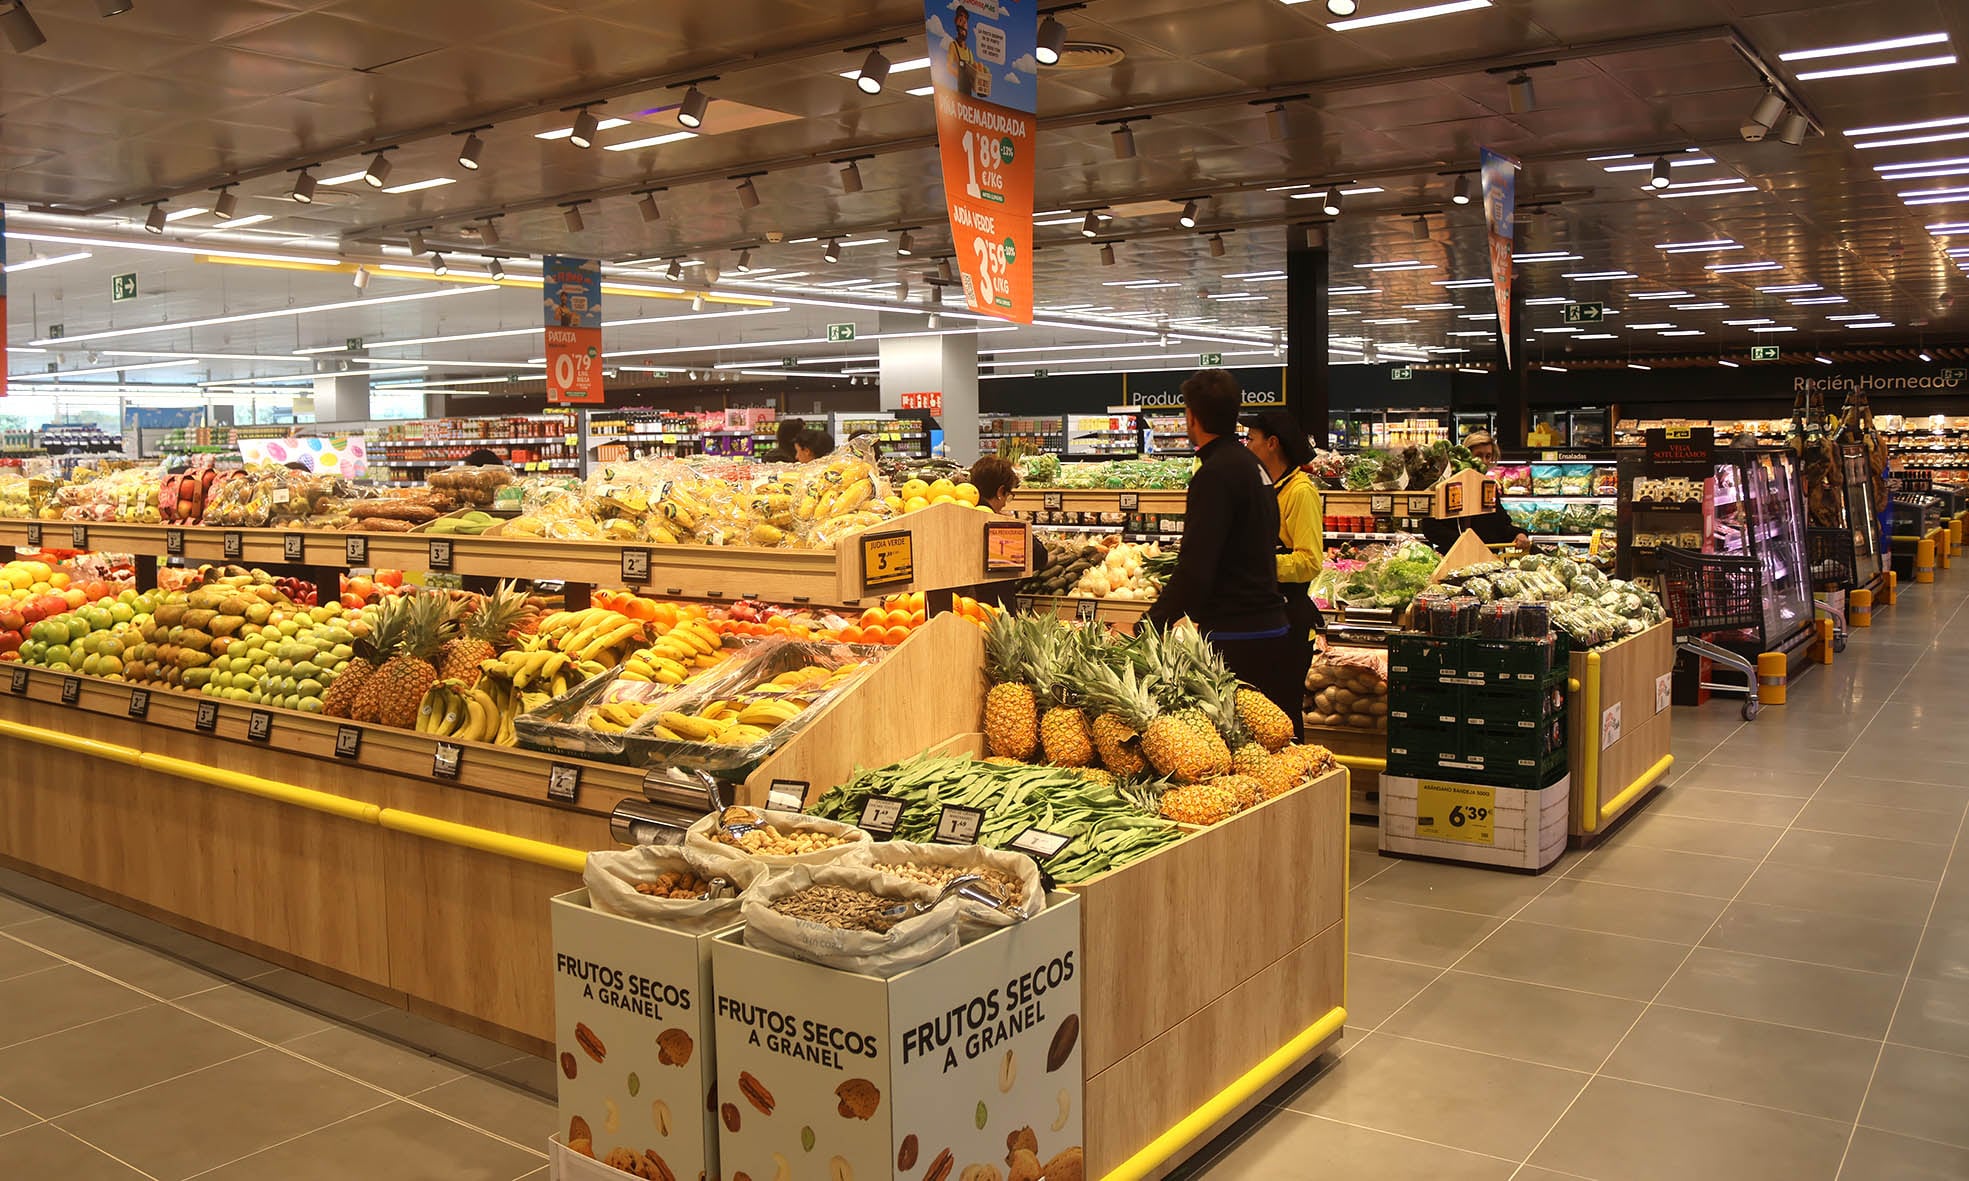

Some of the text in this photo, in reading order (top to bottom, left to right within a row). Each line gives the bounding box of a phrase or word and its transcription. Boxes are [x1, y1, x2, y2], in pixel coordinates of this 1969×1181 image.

[957, 102, 1026, 138] PREMADURADA
[981, 170, 1003, 189] €/KG
[972, 212, 995, 235] VERDE
[548, 331, 576, 343] PATATA
[1133, 389, 1275, 406] Produc teos
[1860, 374, 1959, 389] Horneado
[870, 538, 905, 550] JUDIA VERDE
[557, 952, 691, 1010] FRUTOS SECOS
[583, 983, 663, 1021] A GRANEL
[903, 950, 1073, 1065] FRUTOS SECOS
[718, 995, 877, 1059] FRUTOS SECOS
[943, 1001, 1045, 1073] A GRANEL
[748, 1029, 844, 1071] A GRANEL
